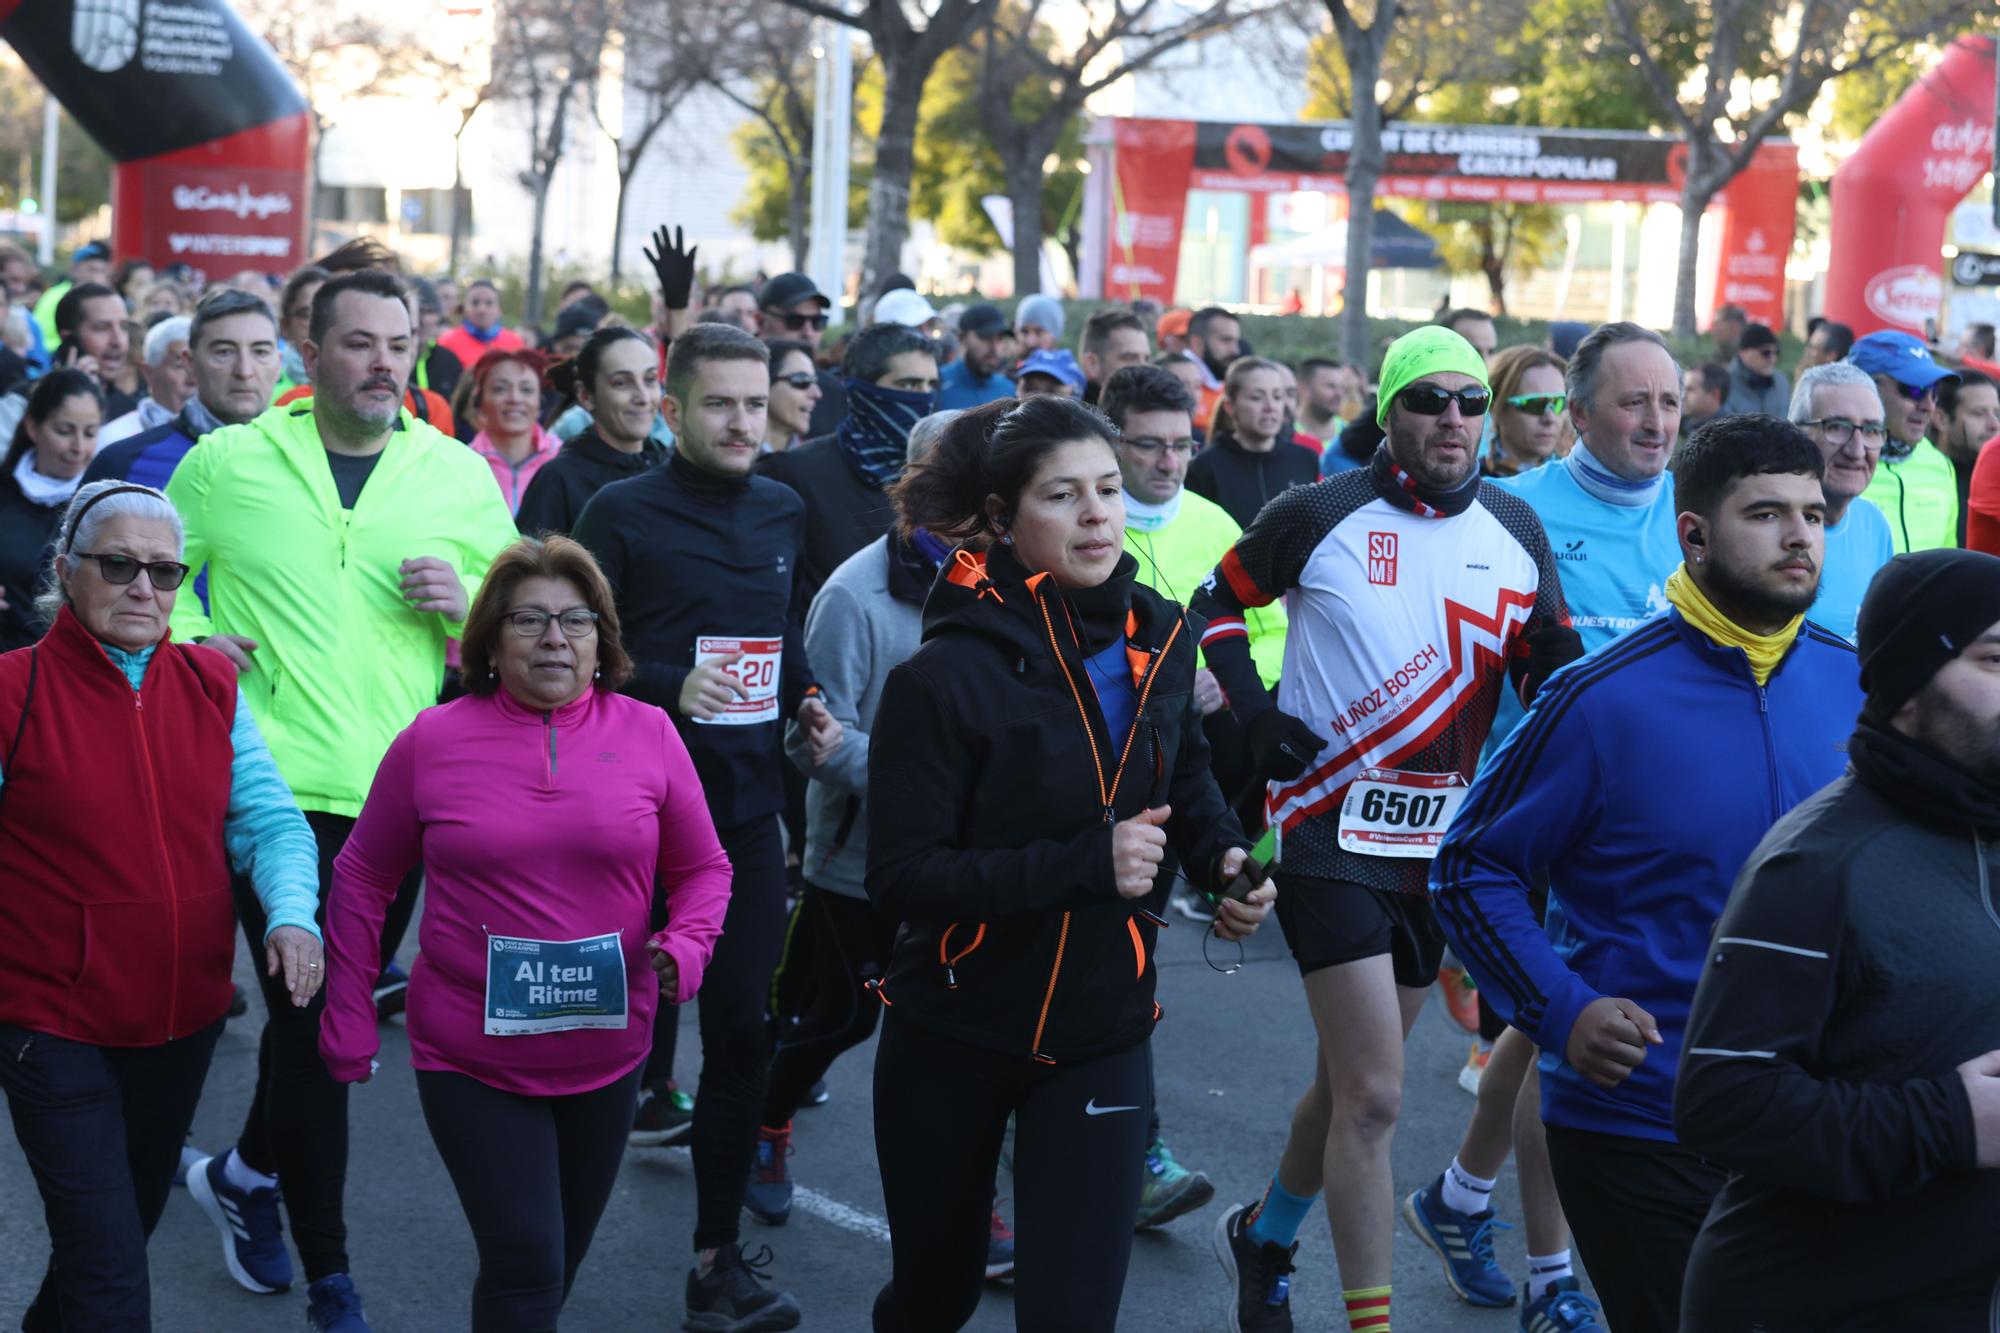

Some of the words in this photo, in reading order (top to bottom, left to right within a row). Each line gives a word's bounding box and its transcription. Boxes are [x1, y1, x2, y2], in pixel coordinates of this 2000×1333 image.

[1458, 154, 1618, 181] CAIXAPOPULAR
[1330, 688, 1388, 736] NUÑOZ
[1383, 643, 1439, 697] BOSCH
[1395, 695, 1413, 711] 1990
[1361, 788, 1448, 828] 6507
[514, 960, 544, 983] Al
[550, 964, 593, 983] teu
[529, 985, 598, 1004] Ritme
